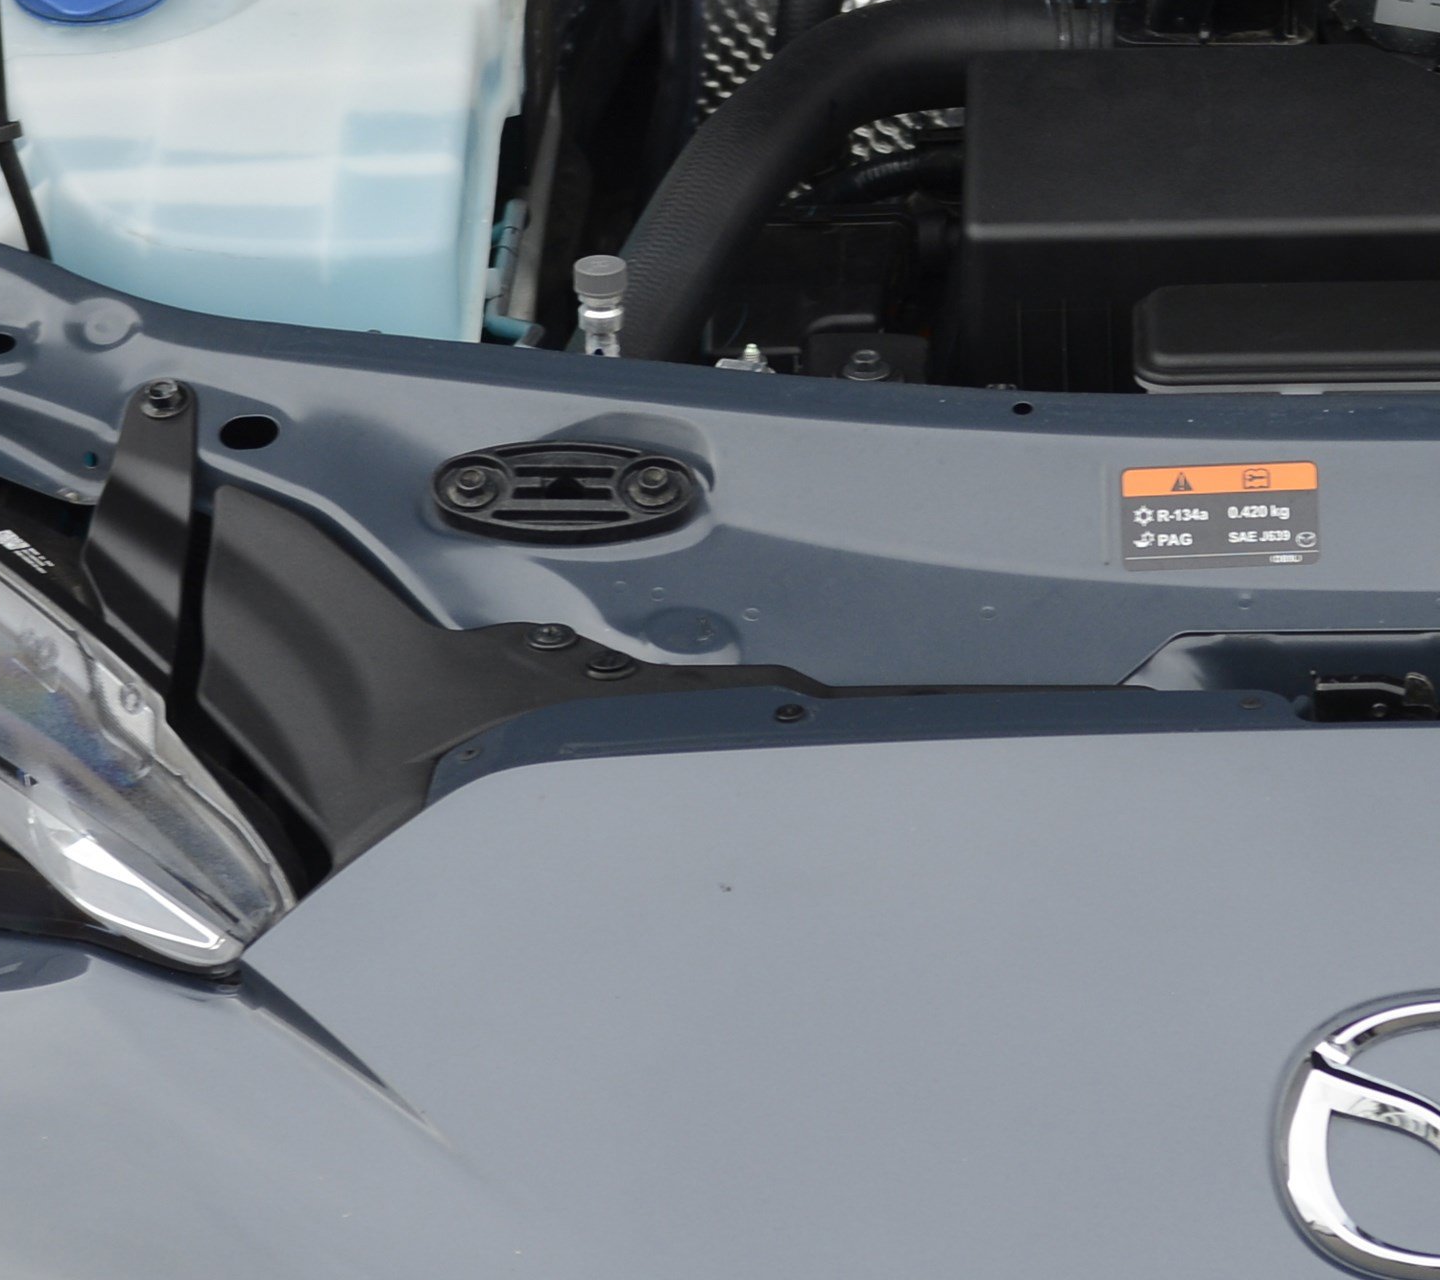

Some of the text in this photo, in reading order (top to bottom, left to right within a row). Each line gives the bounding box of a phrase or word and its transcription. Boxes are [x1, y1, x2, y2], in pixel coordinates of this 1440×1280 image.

[1156, 504, 1291, 523] R-134a 0.420 kg
[1157, 529, 1292, 548] PAG SAE J639
